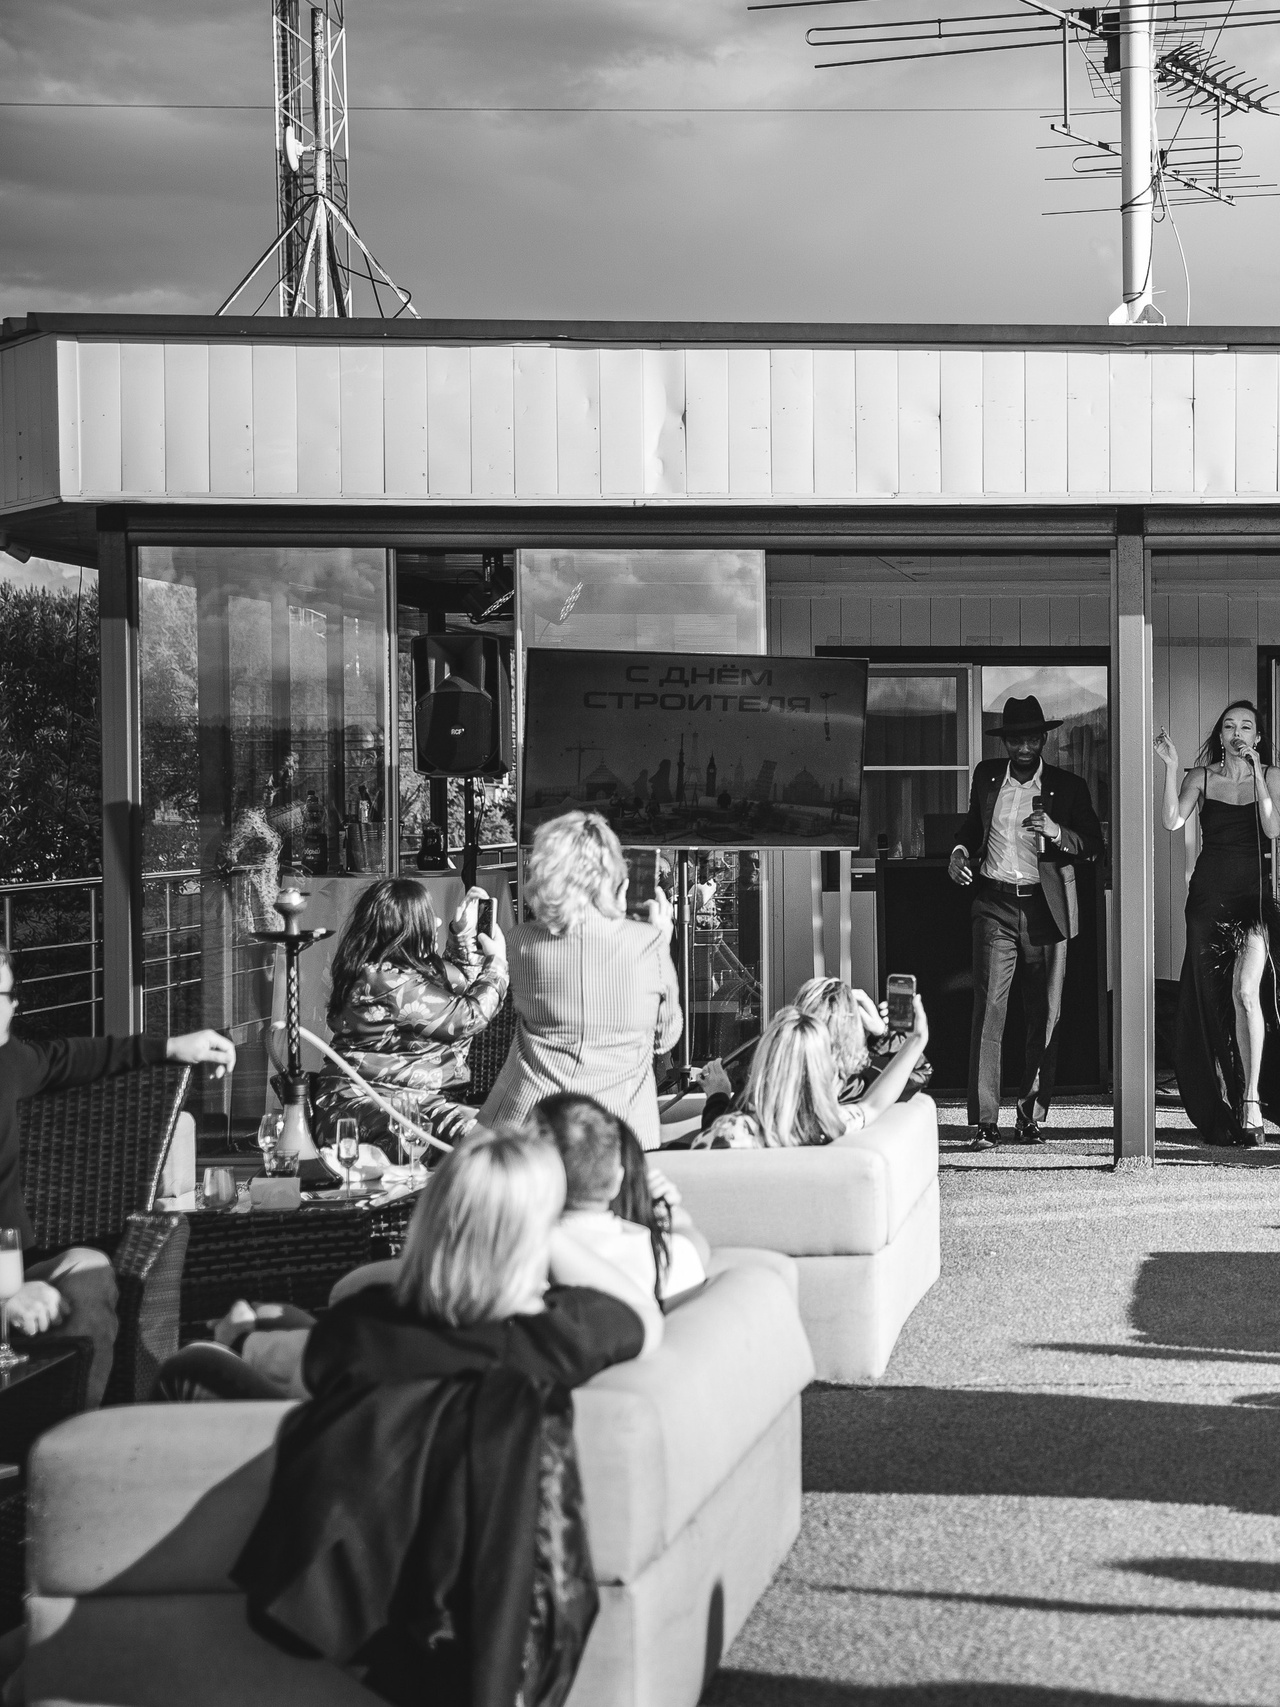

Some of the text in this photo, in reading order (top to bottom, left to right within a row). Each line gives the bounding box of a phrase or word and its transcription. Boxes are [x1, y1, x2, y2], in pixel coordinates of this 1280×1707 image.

[626, 664, 773, 688] С ДНЁМ
[583, 691, 811, 713] СТРОИТЕЛЯ
